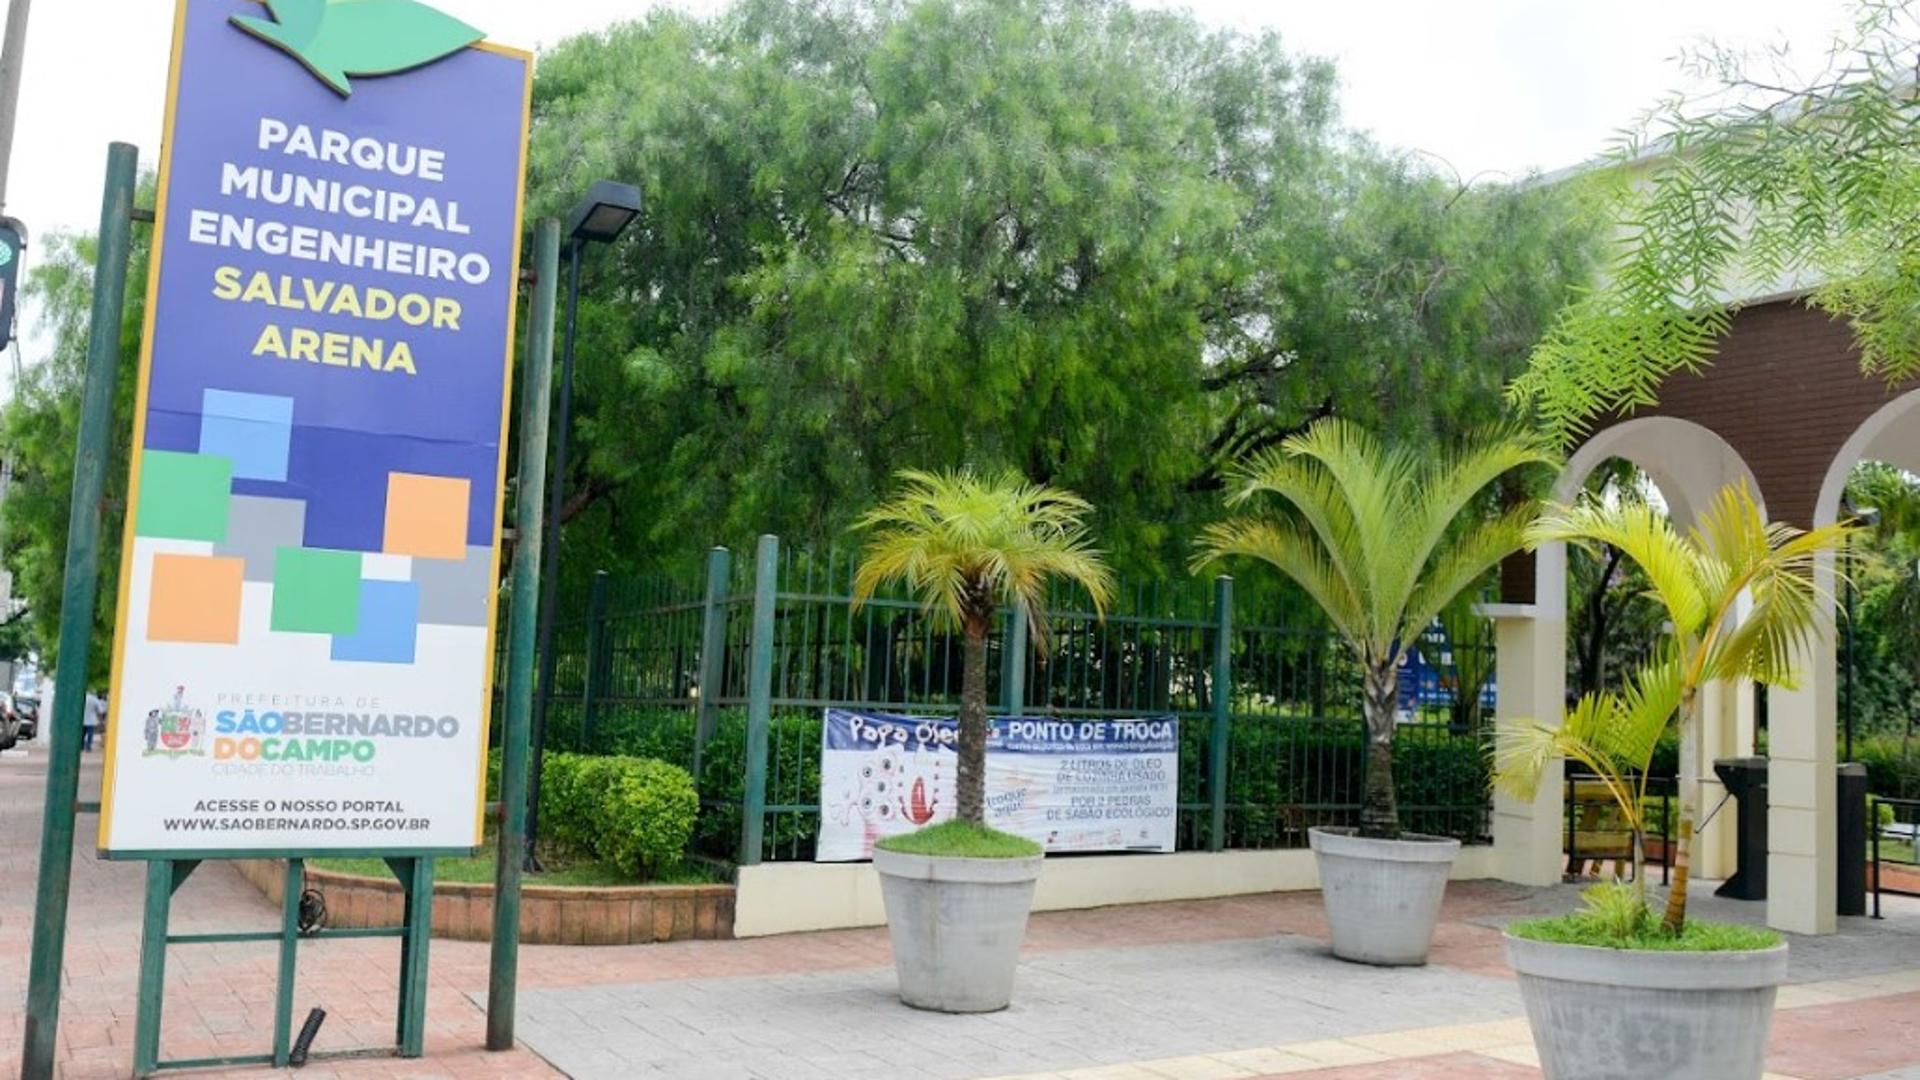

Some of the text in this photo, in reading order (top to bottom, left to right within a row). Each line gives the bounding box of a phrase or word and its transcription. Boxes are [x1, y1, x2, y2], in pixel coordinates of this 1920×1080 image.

[258, 117, 446, 182] PARQUE
[220, 162, 470, 234] MUNICIPAL
[189, 208, 491, 285] ENGENHEIRO
[212, 265, 461, 331] SALVADOR
[252, 324, 416, 375] ARENA
[217, 692, 380, 709] PREFEITURA DE
[1009, 722, 1173, 741] PONTO DE TROCA
[163, 817, 431, 831] WWW.SAOBERNARDO.SP.GOV.BR
[194, 800, 404, 812] ACESSE O NOSSO PORTAL
